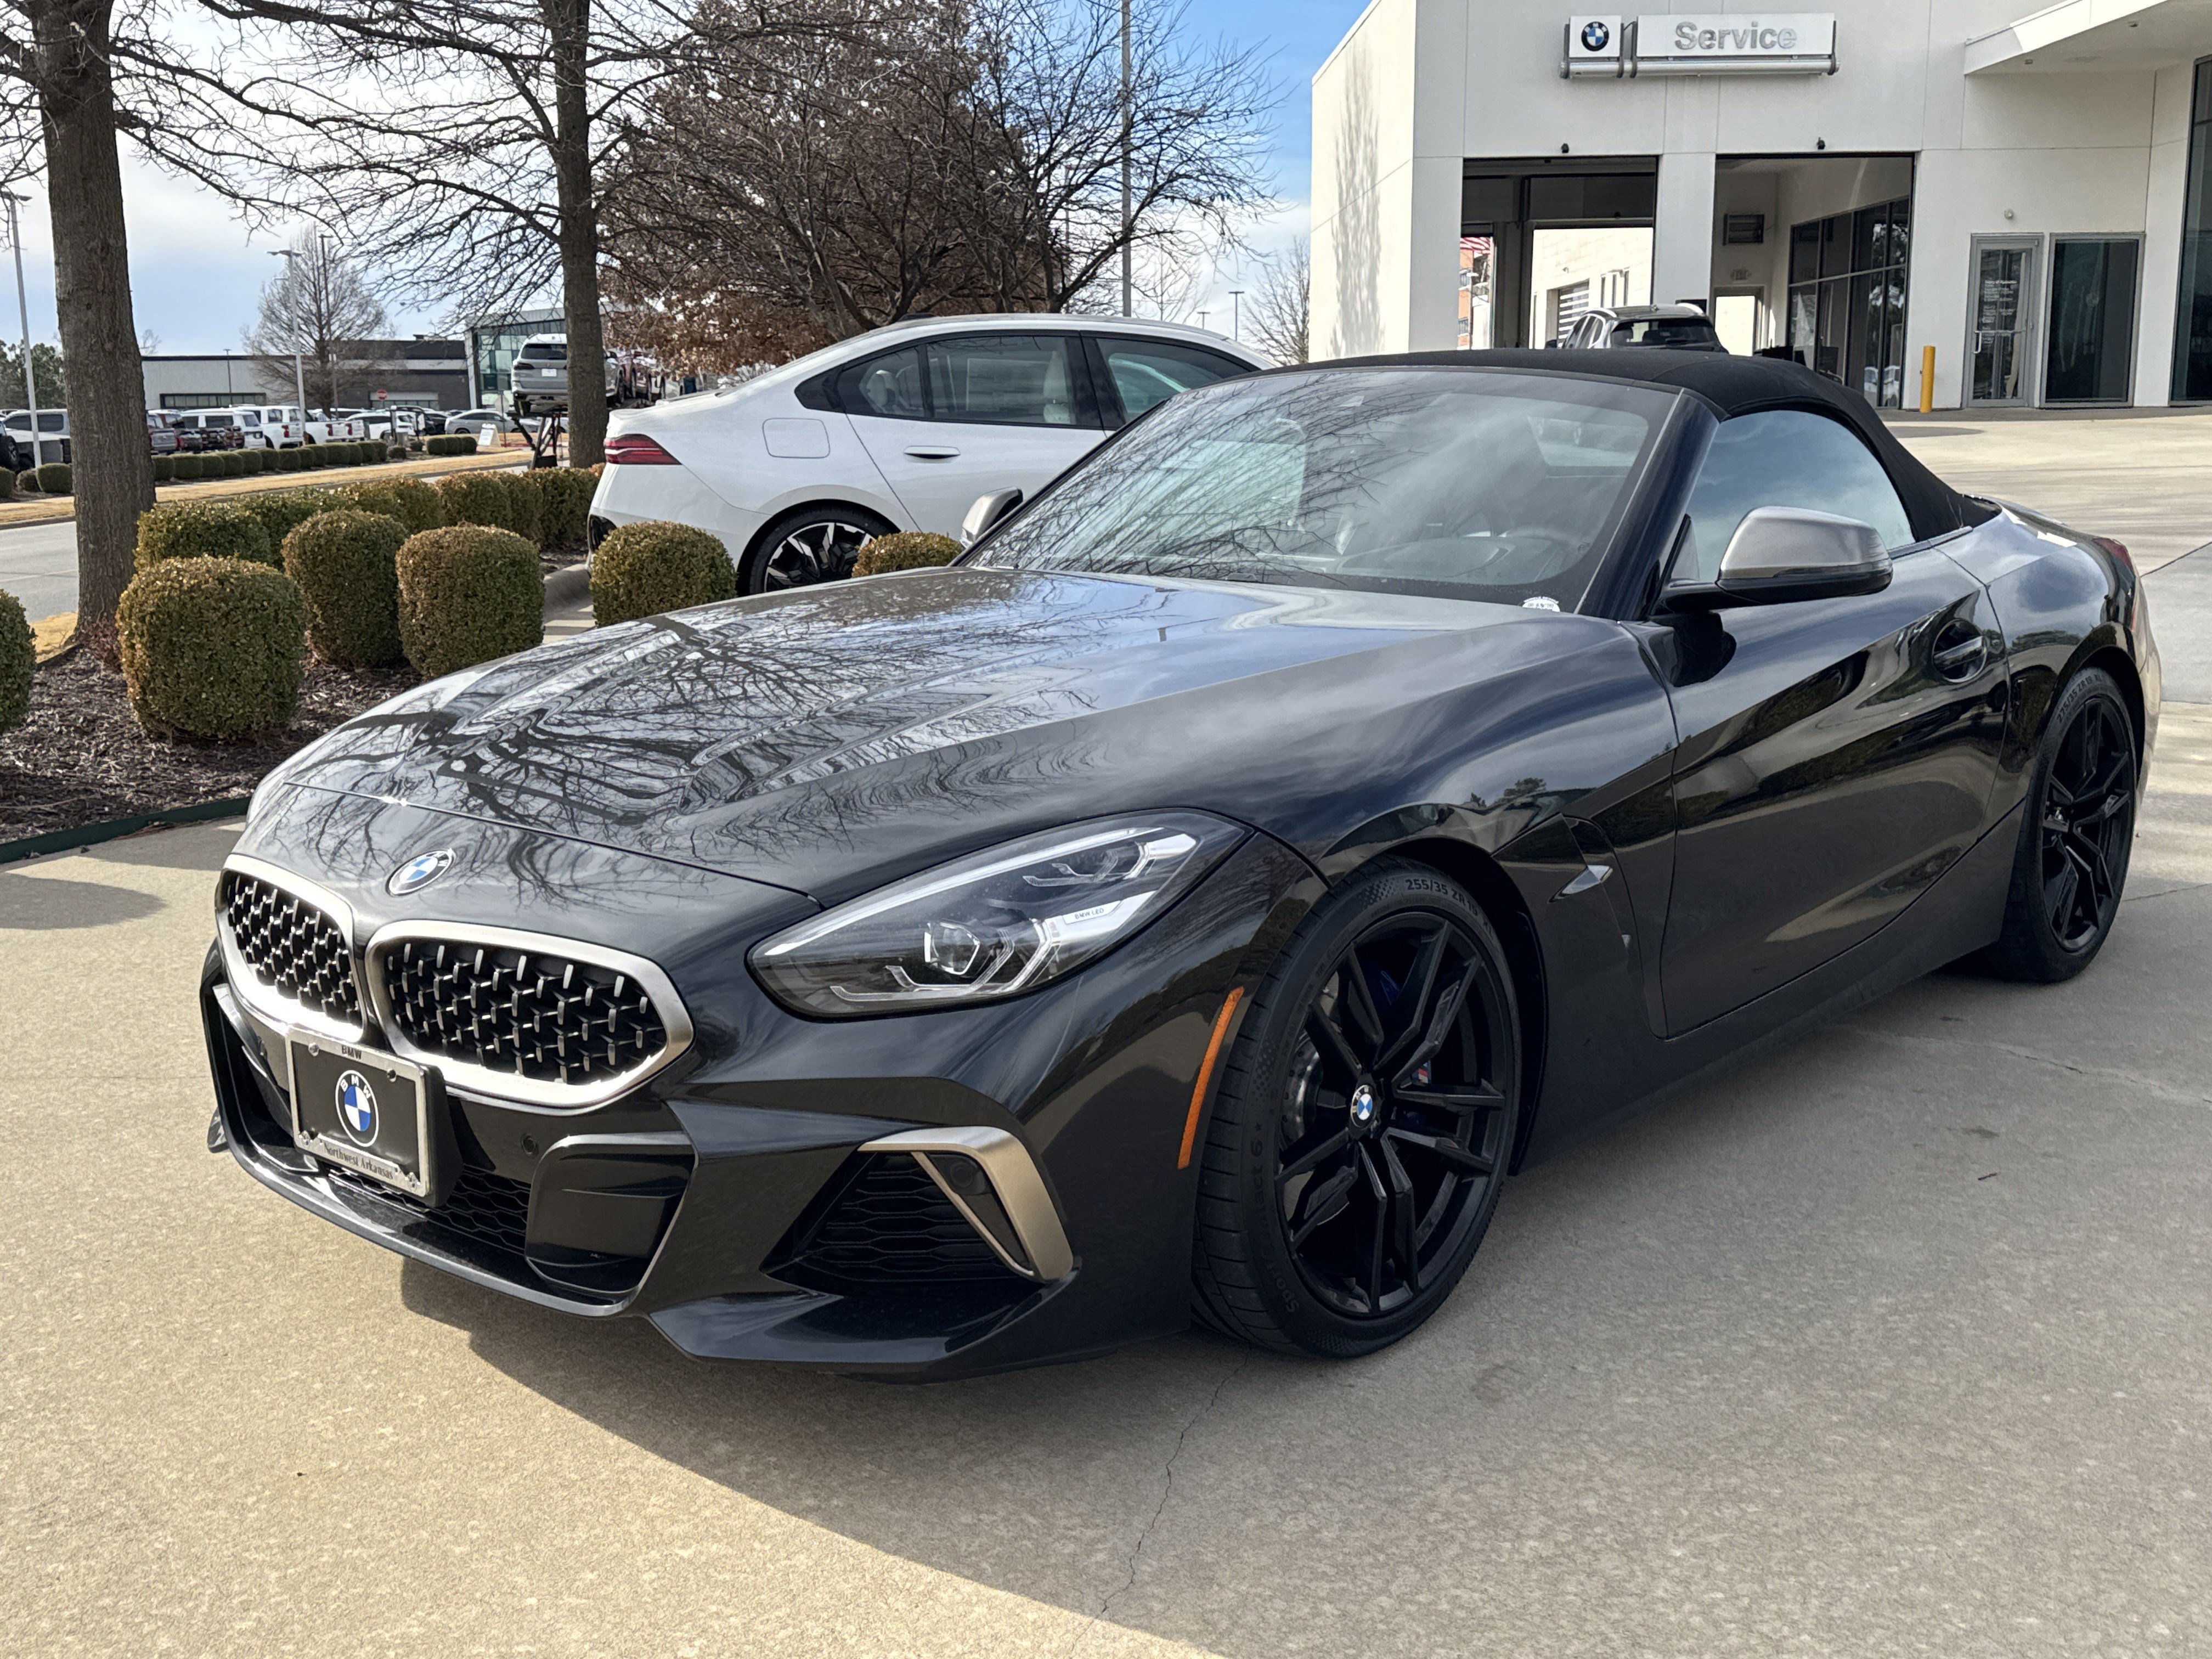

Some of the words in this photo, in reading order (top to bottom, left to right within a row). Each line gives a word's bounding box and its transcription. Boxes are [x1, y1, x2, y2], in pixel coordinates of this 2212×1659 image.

[1675, 21, 1797, 50] Service
[1406, 879, 1448, 895] 255/35
[341, 1045, 362, 1060] BMW
[340, 1074, 371, 1099] BMW
[324, 1142, 359, 1166] Northwest
[360, 1157, 393, 1180] Arkansas
